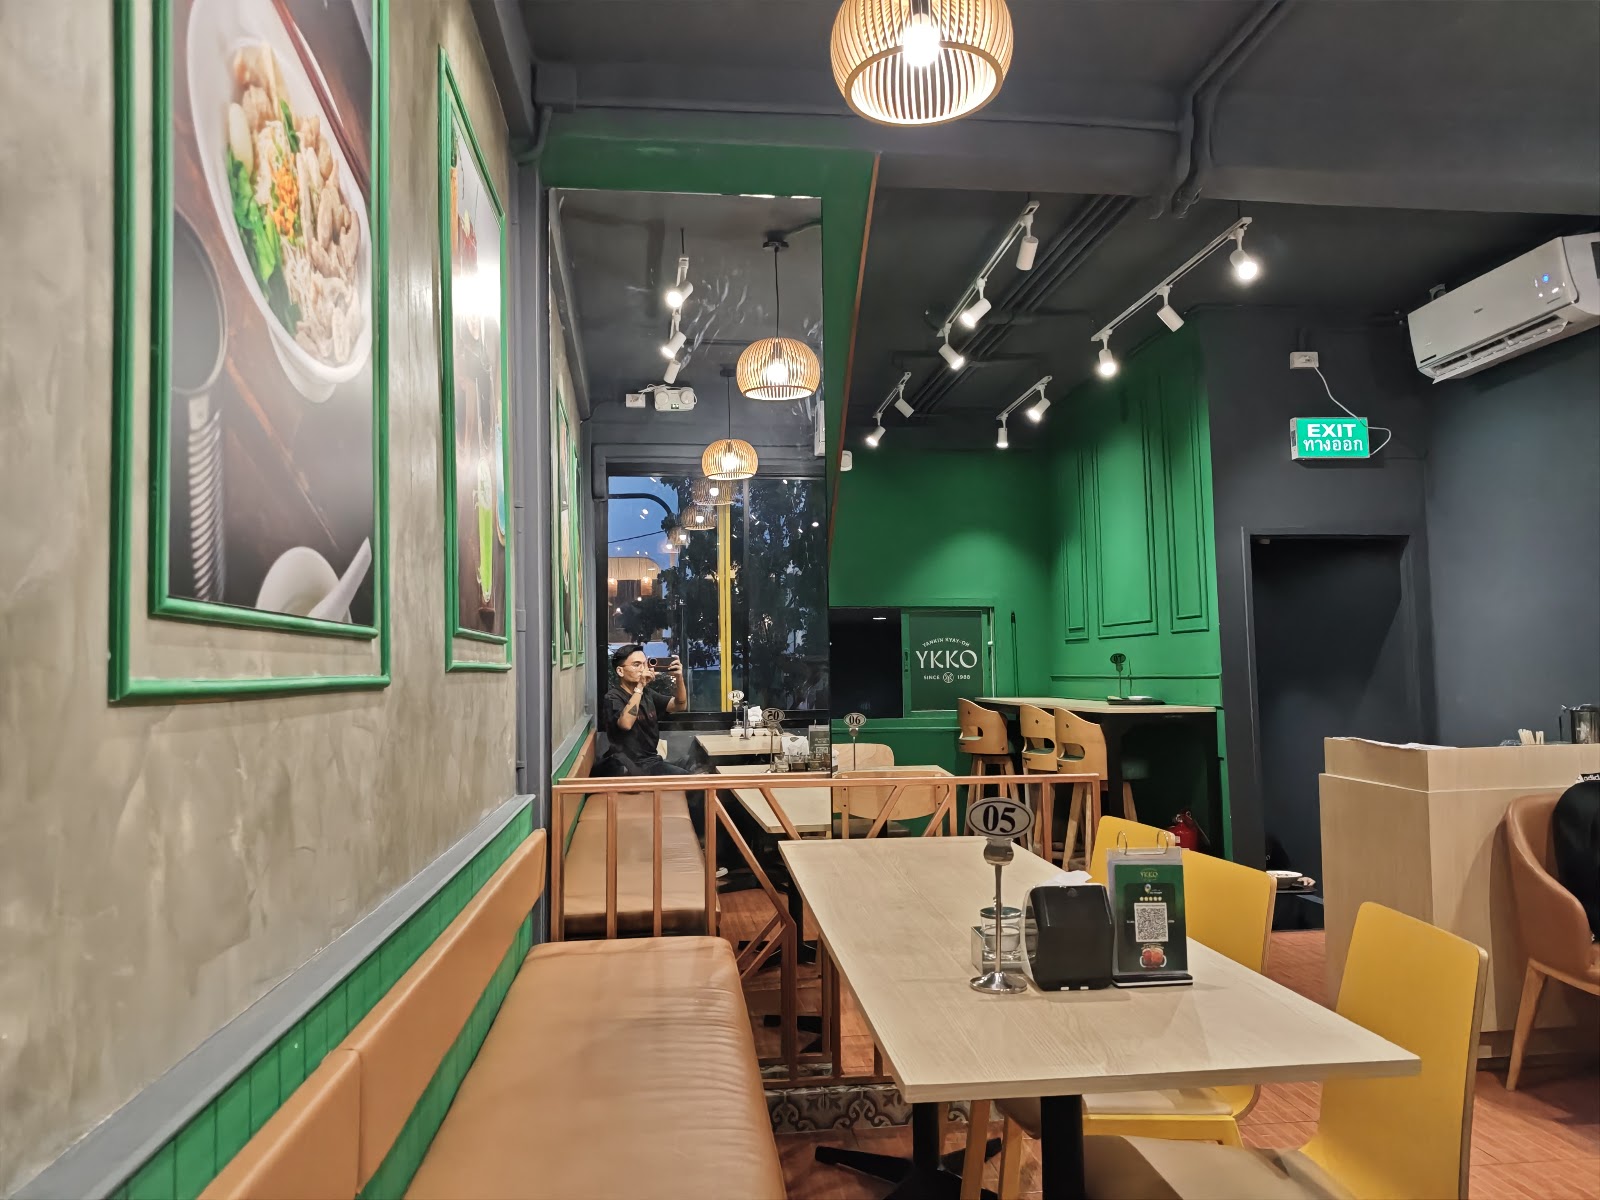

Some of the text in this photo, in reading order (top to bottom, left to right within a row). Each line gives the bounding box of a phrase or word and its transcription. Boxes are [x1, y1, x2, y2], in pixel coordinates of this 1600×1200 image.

[1307, 423, 1356, 437] EXIT
[1303, 439, 1363, 451] ทางออก
[915, 649, 978, 668] YKKO
[848, 715, 861, 725] 06
[982, 804, 1016, 834] 05
